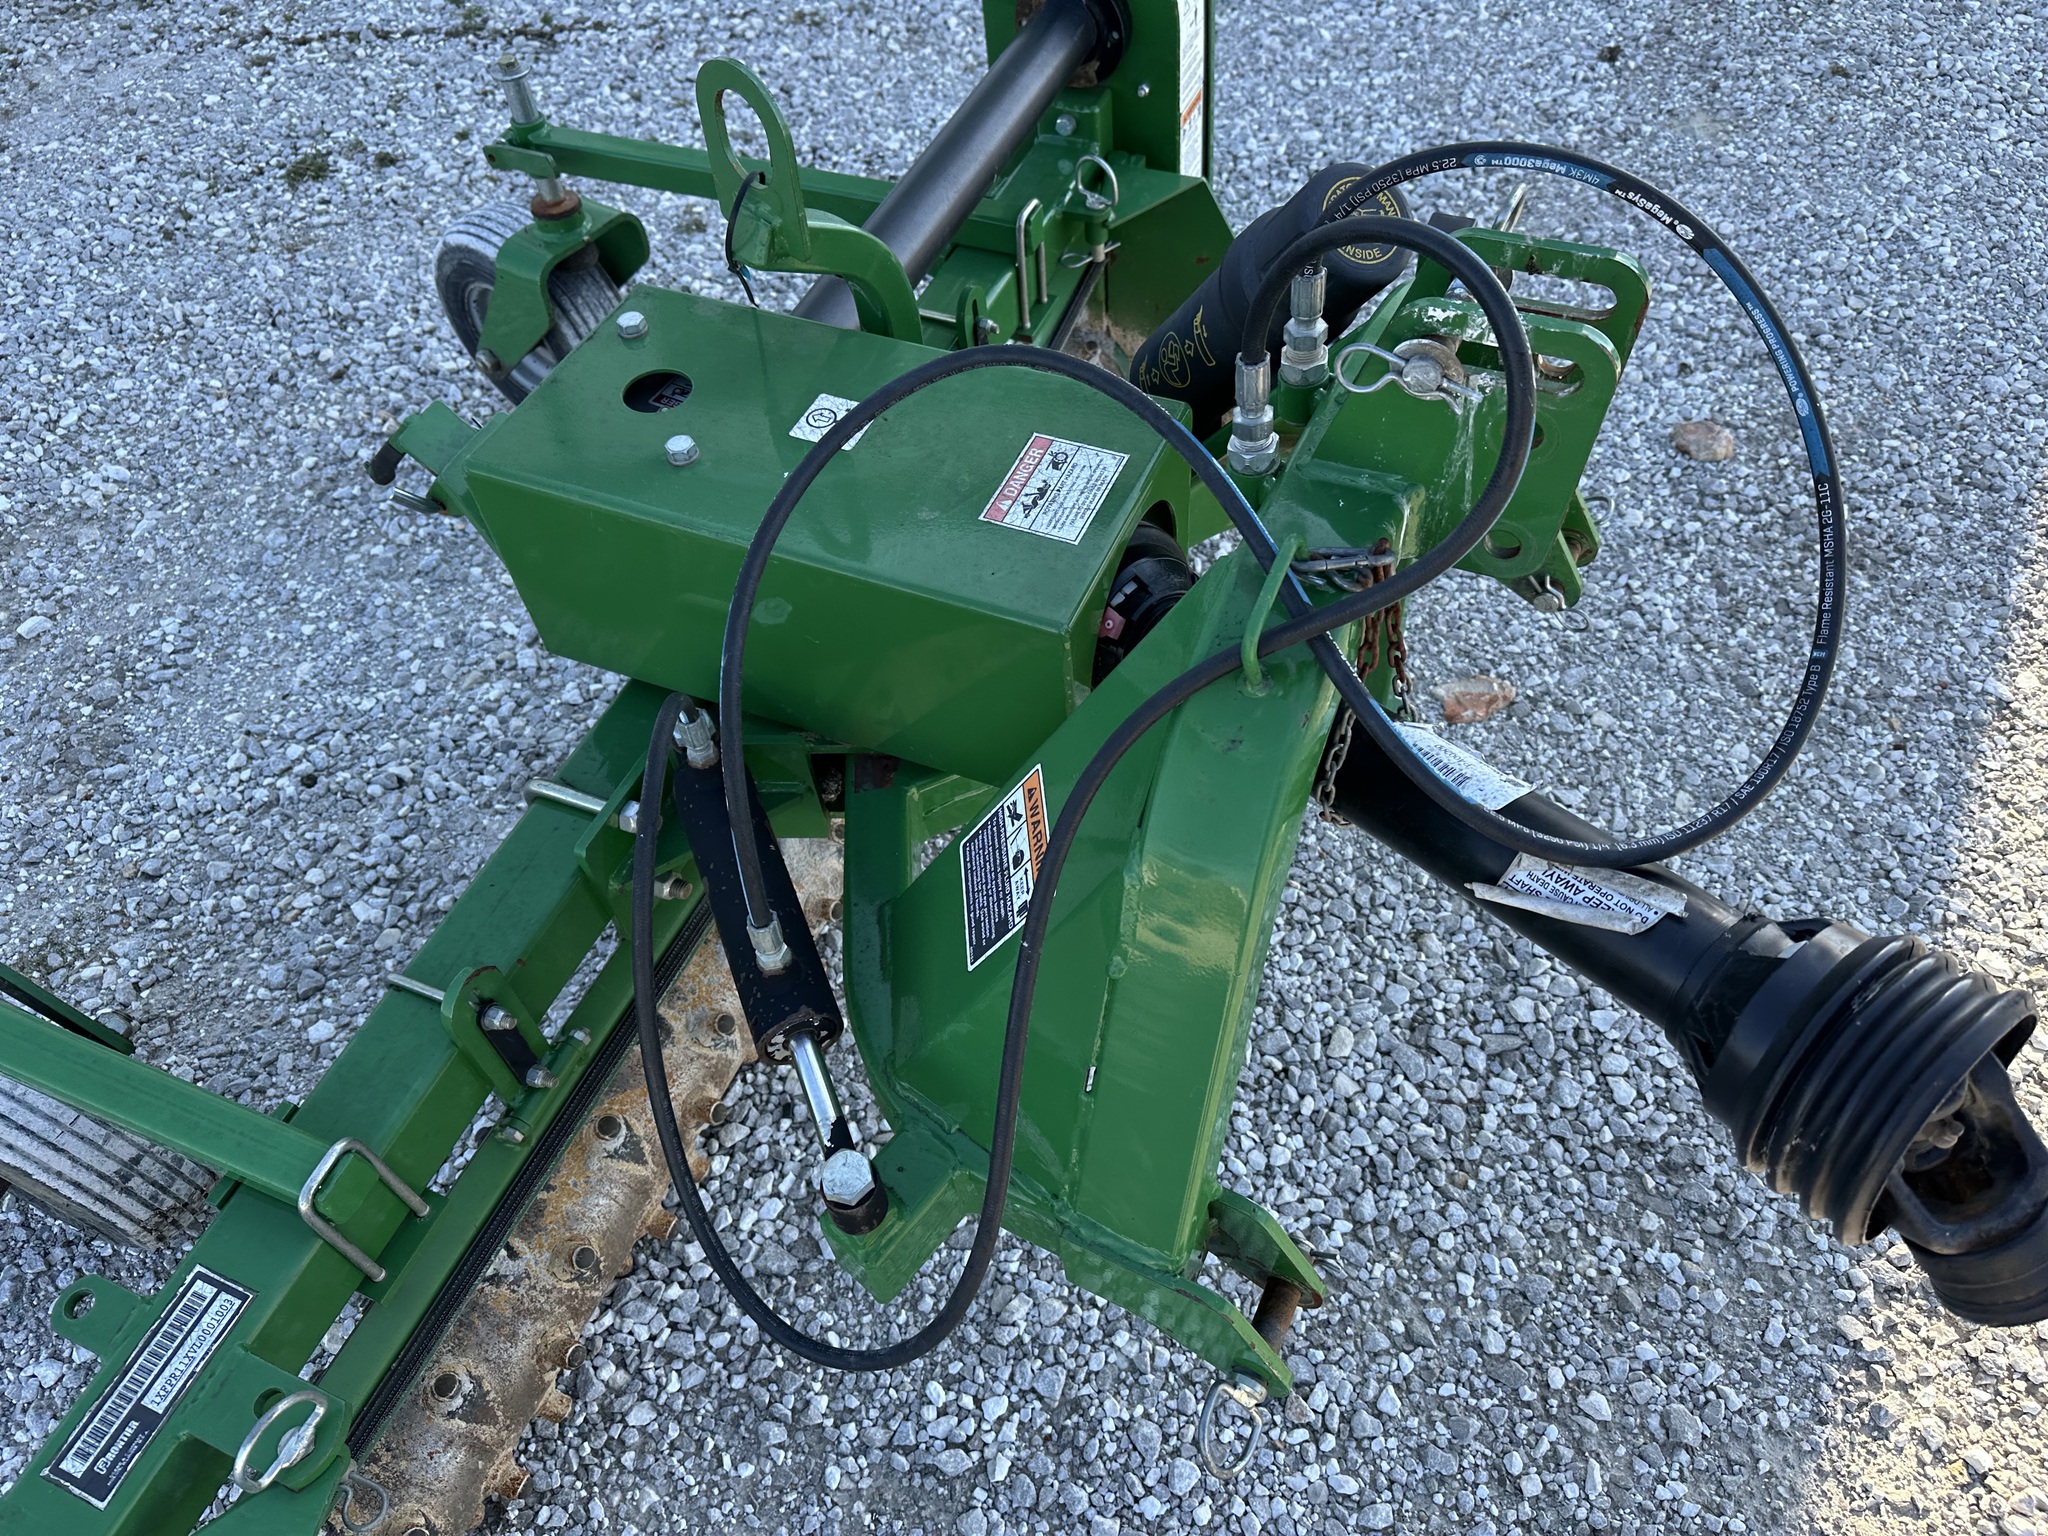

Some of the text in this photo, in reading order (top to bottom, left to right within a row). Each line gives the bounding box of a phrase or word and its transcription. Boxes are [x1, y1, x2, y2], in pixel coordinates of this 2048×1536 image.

[1405, 163, 1429, 176] MPa
[1431, 157, 1456, 169] 22.5
[1568, 167, 1599, 184] 4M3K
[1342, 244, 1382, 260] NSIDE
[1777, 349, 1799, 392] POWERING
[1005, 447, 1045, 497] DANGER
[1818, 483, 1834, 644] Flame Resistant MSHA 2G-11C
[1664, 830, 1682, 840] ISO
[1686, 816, 1712, 833] 11237
[1713, 800, 1731, 817] R17
[1735, 784, 1754, 799] SAE
[1753, 754, 1779, 784] 100R17
[1780, 730, 1794, 745] ISO
[1789, 698, 1810, 728] 18752
[1804, 674, 1818, 695] Type
[998, 807, 1007, 869] HIGH-PRESSURE
[1029, 803, 1047, 872] WARN
[1508, 874, 1542, 897] SHAFT
[1526, 870, 1550, 890] DEATH
[1540, 869, 1586, 896] AWAY!
[1572, 875, 1613, 901] OPERATE
[1548, 886, 1574, 903] CAUSE
[1582, 895, 1615, 911] EEP
[1615, 901, 1635, 914] NOT
[94, 1420, 140, 1475] FRONTIER
